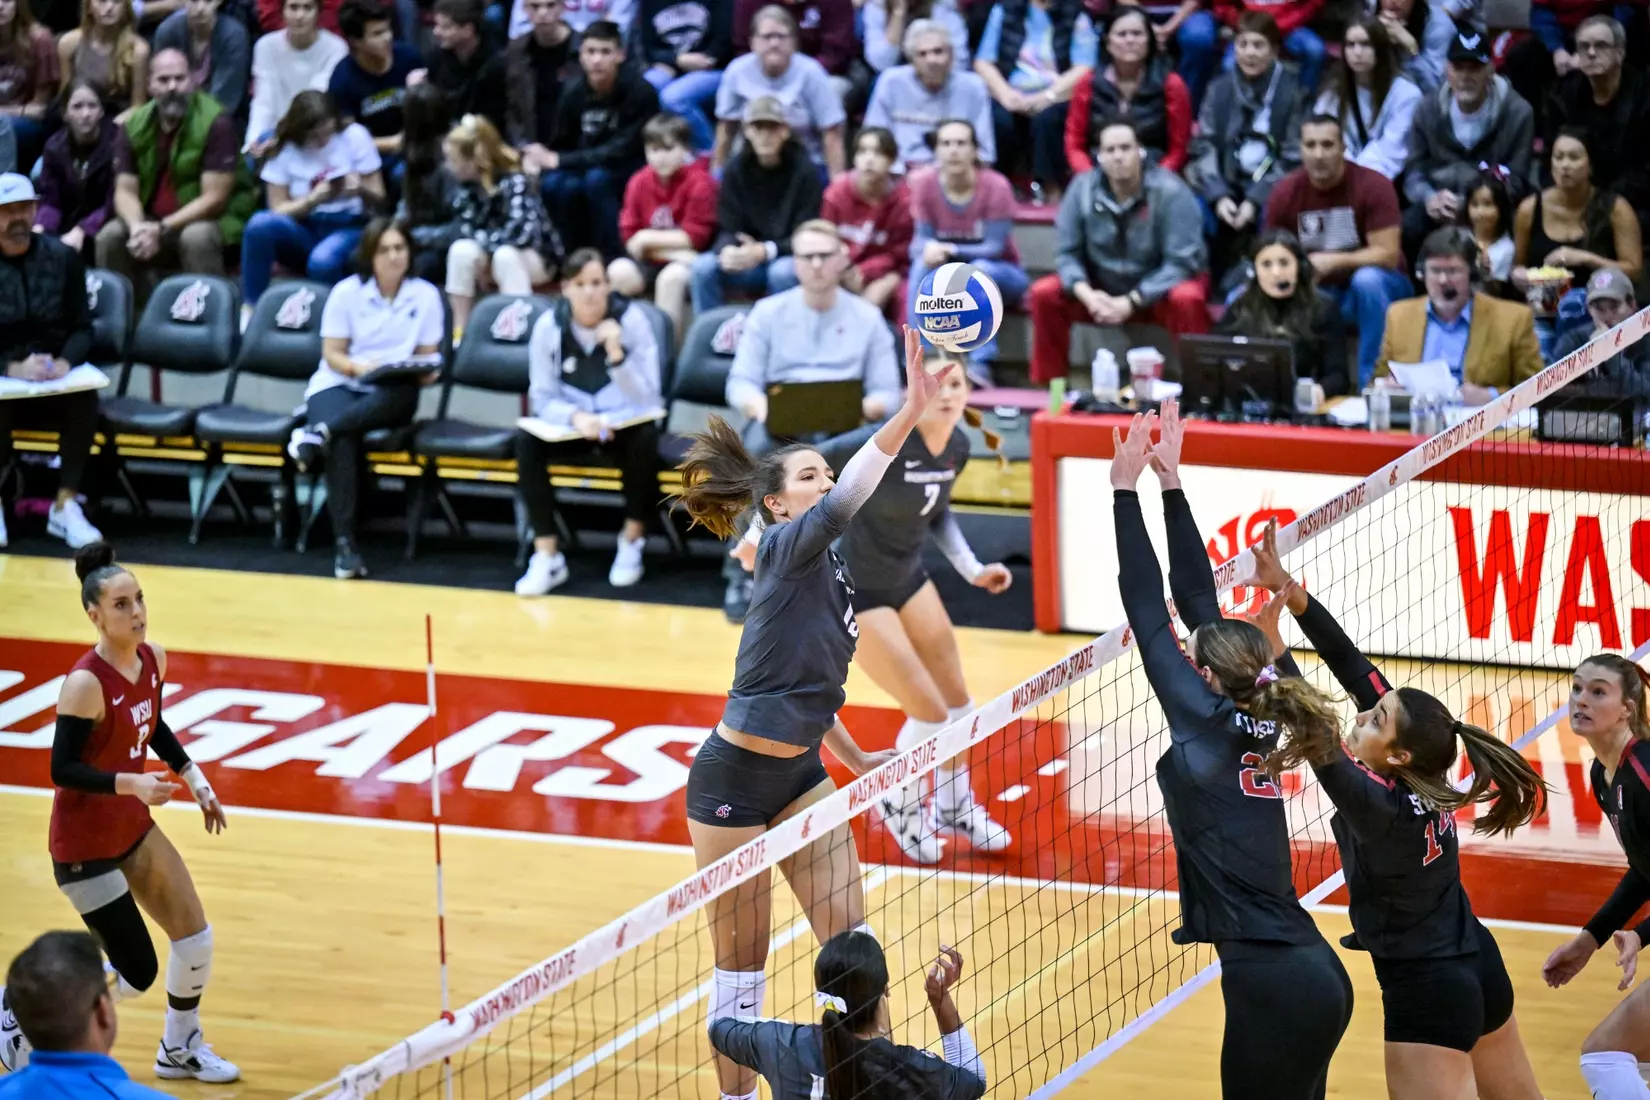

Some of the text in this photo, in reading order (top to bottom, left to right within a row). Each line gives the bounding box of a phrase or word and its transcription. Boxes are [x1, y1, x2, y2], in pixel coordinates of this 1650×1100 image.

[920, 297, 963, 311] molten
[924, 314, 961, 331] NCAA
[1536, 343, 1595, 396] WASHINGTON STATE
[1421, 410, 1485, 464] WASHINGTON STATE
[919, 483, 941, 516] 7
[1297, 482, 1366, 543] WASHINGTON STATE
[1011, 644, 1094, 714] WASHINGTON STATE
[130, 698, 152, 727] WSU
[849, 737, 938, 811] WASHINGTON STATE
[666, 838, 767, 918] WASHINGTON STATE
[542, 949, 576, 990] STATE
